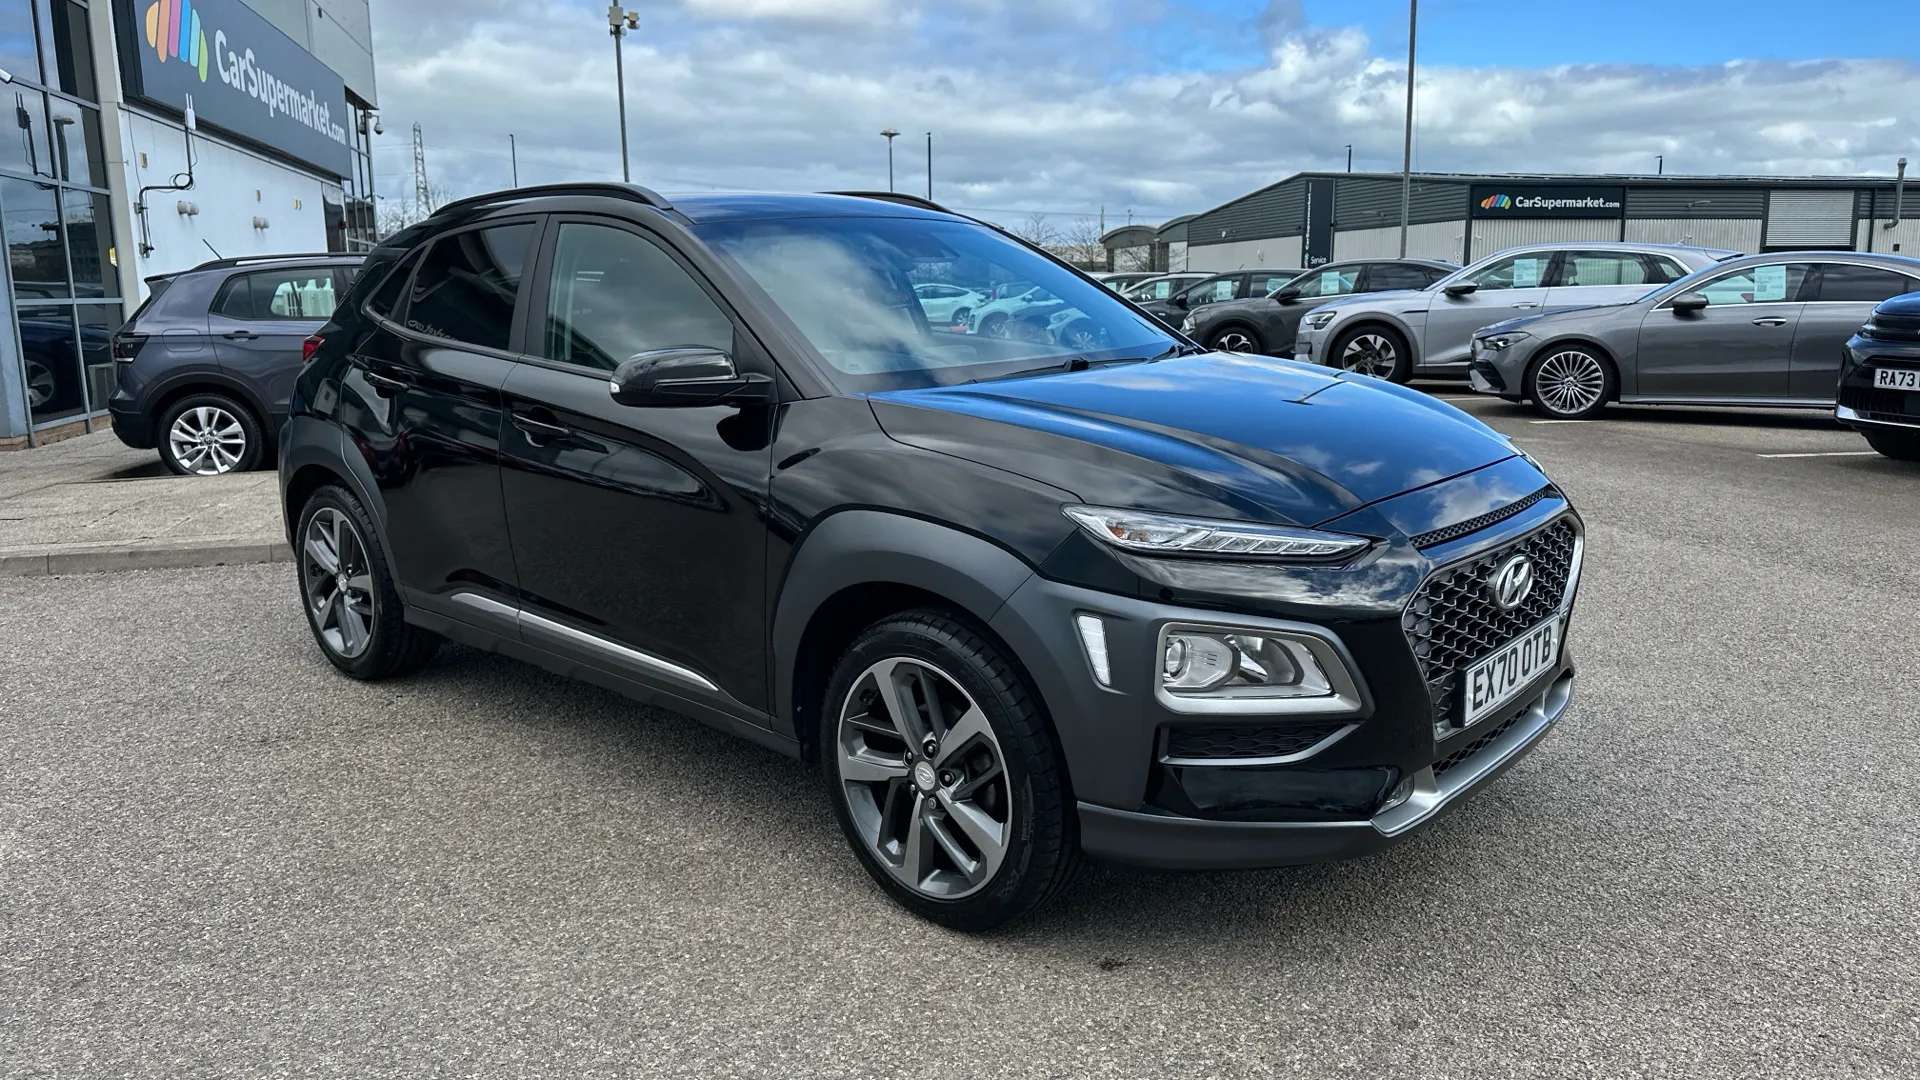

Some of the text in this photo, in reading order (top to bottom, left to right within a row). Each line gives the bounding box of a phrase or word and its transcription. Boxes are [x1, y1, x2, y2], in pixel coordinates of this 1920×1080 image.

[214, 29, 346, 145] CarSupermarket.com
[1515, 196, 1620, 210] CarSupermarket.com
[1879, 370, 1915, 387] RA73
